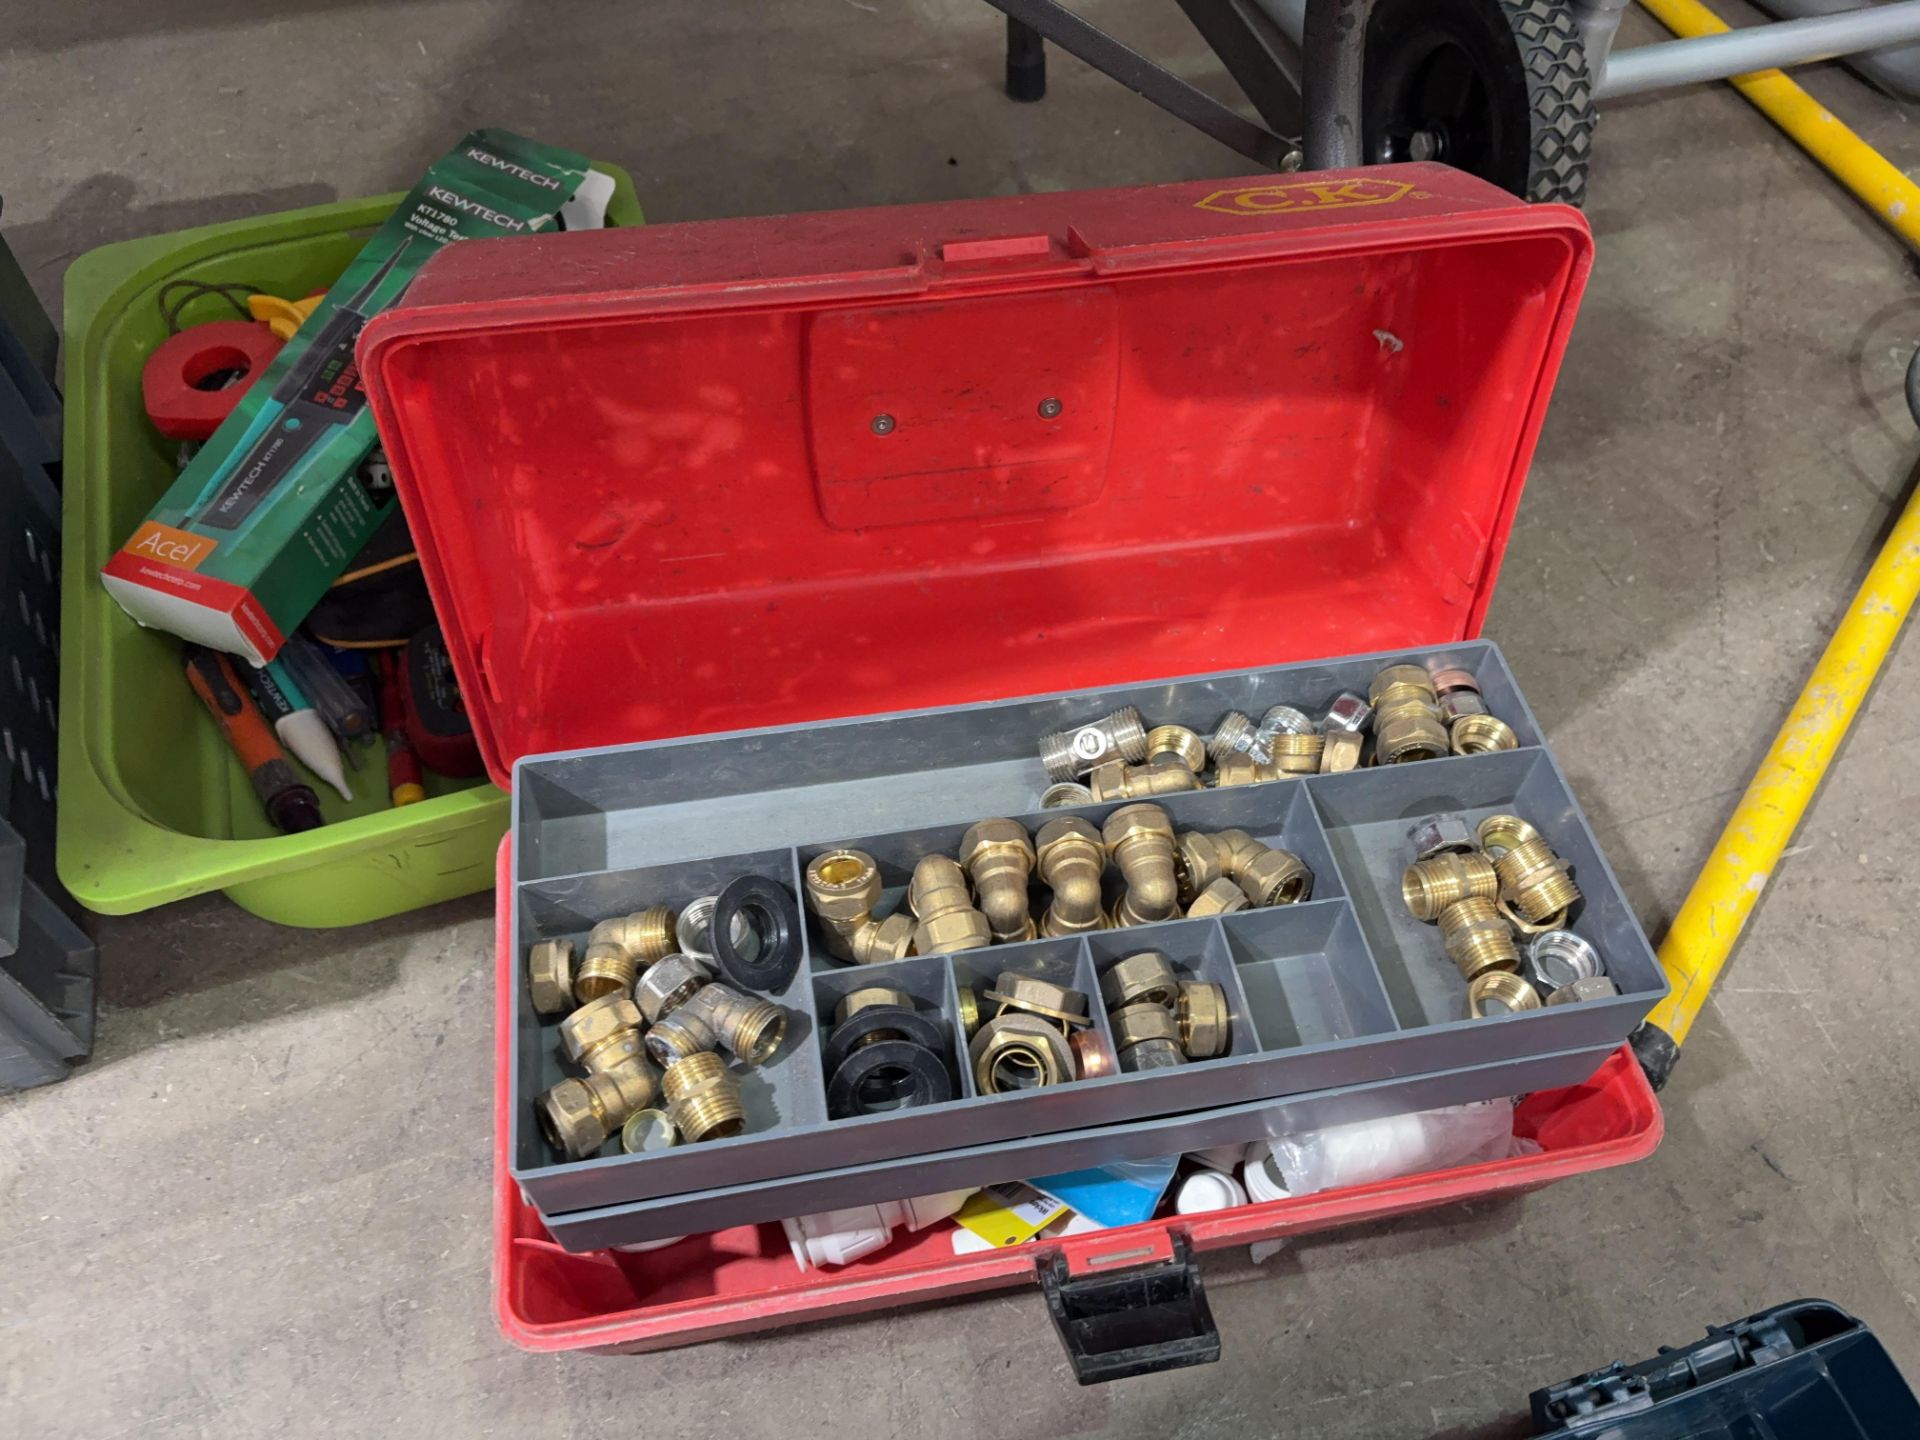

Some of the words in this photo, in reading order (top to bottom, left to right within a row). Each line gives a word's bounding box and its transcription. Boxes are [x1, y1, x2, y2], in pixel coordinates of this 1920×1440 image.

[467, 149, 560, 190] KEWTECH
[410, 213, 446, 238] Voltage
[417, 203, 458, 226] KT1780
[429, 186, 524, 231] KEWTECH
[219, 461, 266, 513] KEWTECH
[136, 532, 201, 562] Acel
